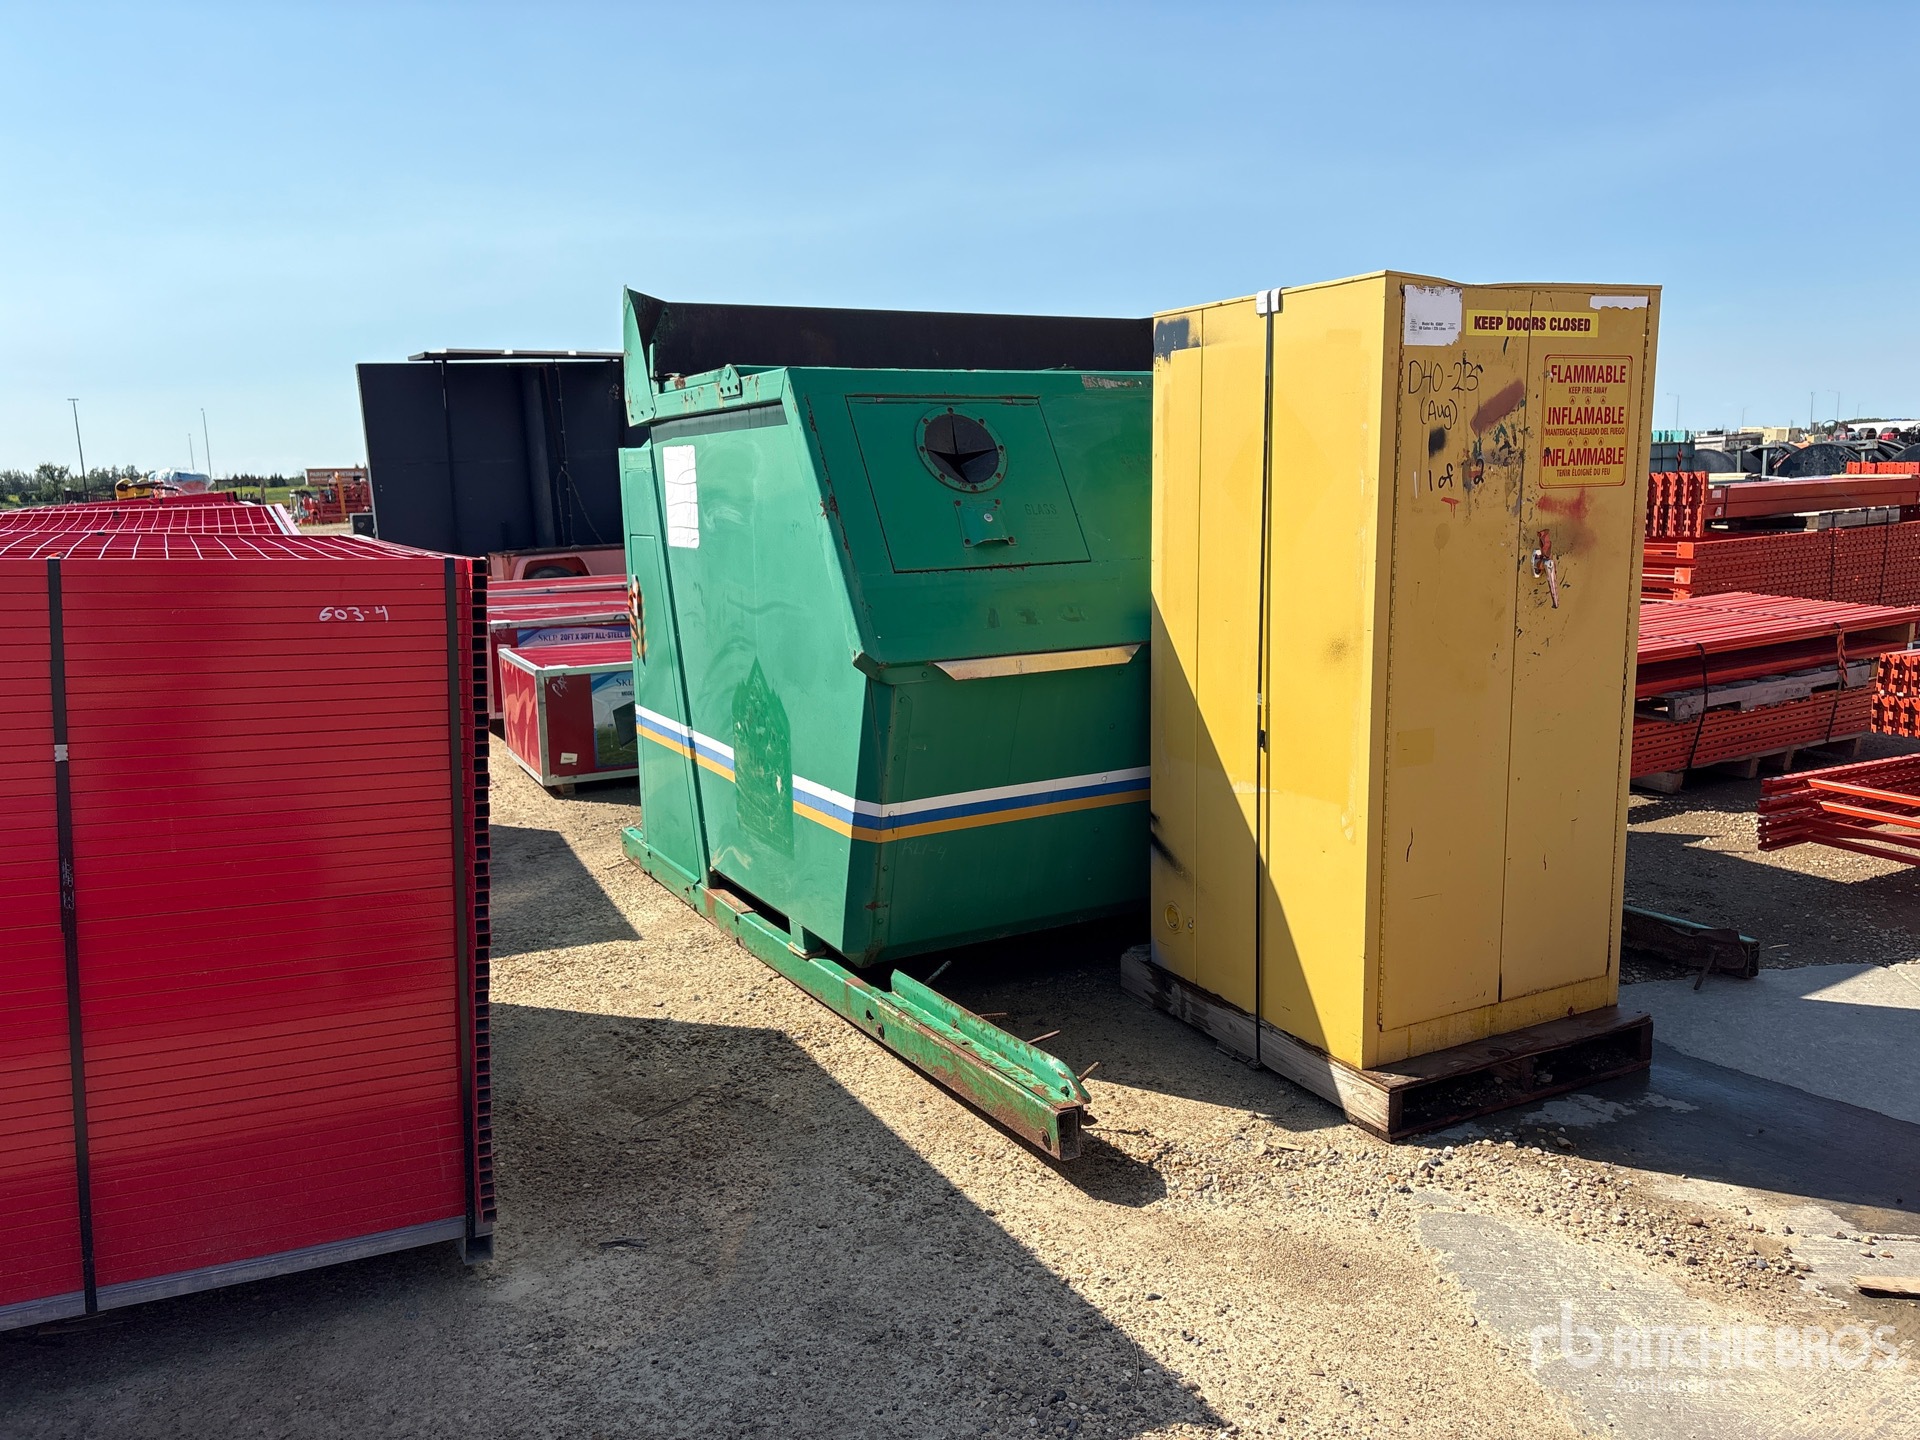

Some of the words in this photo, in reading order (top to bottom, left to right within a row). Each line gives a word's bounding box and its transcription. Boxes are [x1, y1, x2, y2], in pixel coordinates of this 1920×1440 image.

[1473, 315, 1504, 331] KEEP
[1506, 316, 1547, 332] DOORS
[1549, 317, 1591, 332] CLOSED
[1550, 364, 1627, 384] FLAMMABLE
[1568, 386, 1581, 395] KEEP
[1581, 386, 1593, 395] FIRE
[1593, 386, 1608, 395] AWAY
[1419, 396, 1459, 431] (Aug)
[1547, 406, 1625, 426] INFLAMABLE
[1579, 427, 1600, 436] ALEJADO
[1600, 427, 1610, 436] DEL
[1610, 426, 1626, 435] FUEGO
[1542, 446, 1625, 467] INFLAMMABLE
[1428, 469, 1434, 492] 1
[1438, 462, 1454, 489] of
[1556, 468, 1571, 478] TENIR
[1593, 467, 1601, 477] DU
[1601, 466, 1612, 476] FEU
[1024, 503, 1058, 516] GLASS
[318, 605, 389, 623] 603-4
[560, 633, 575, 641] 20FT
[580, 632, 595, 640] 30FT
[595, 630, 624, 639] ALL-STEEL
